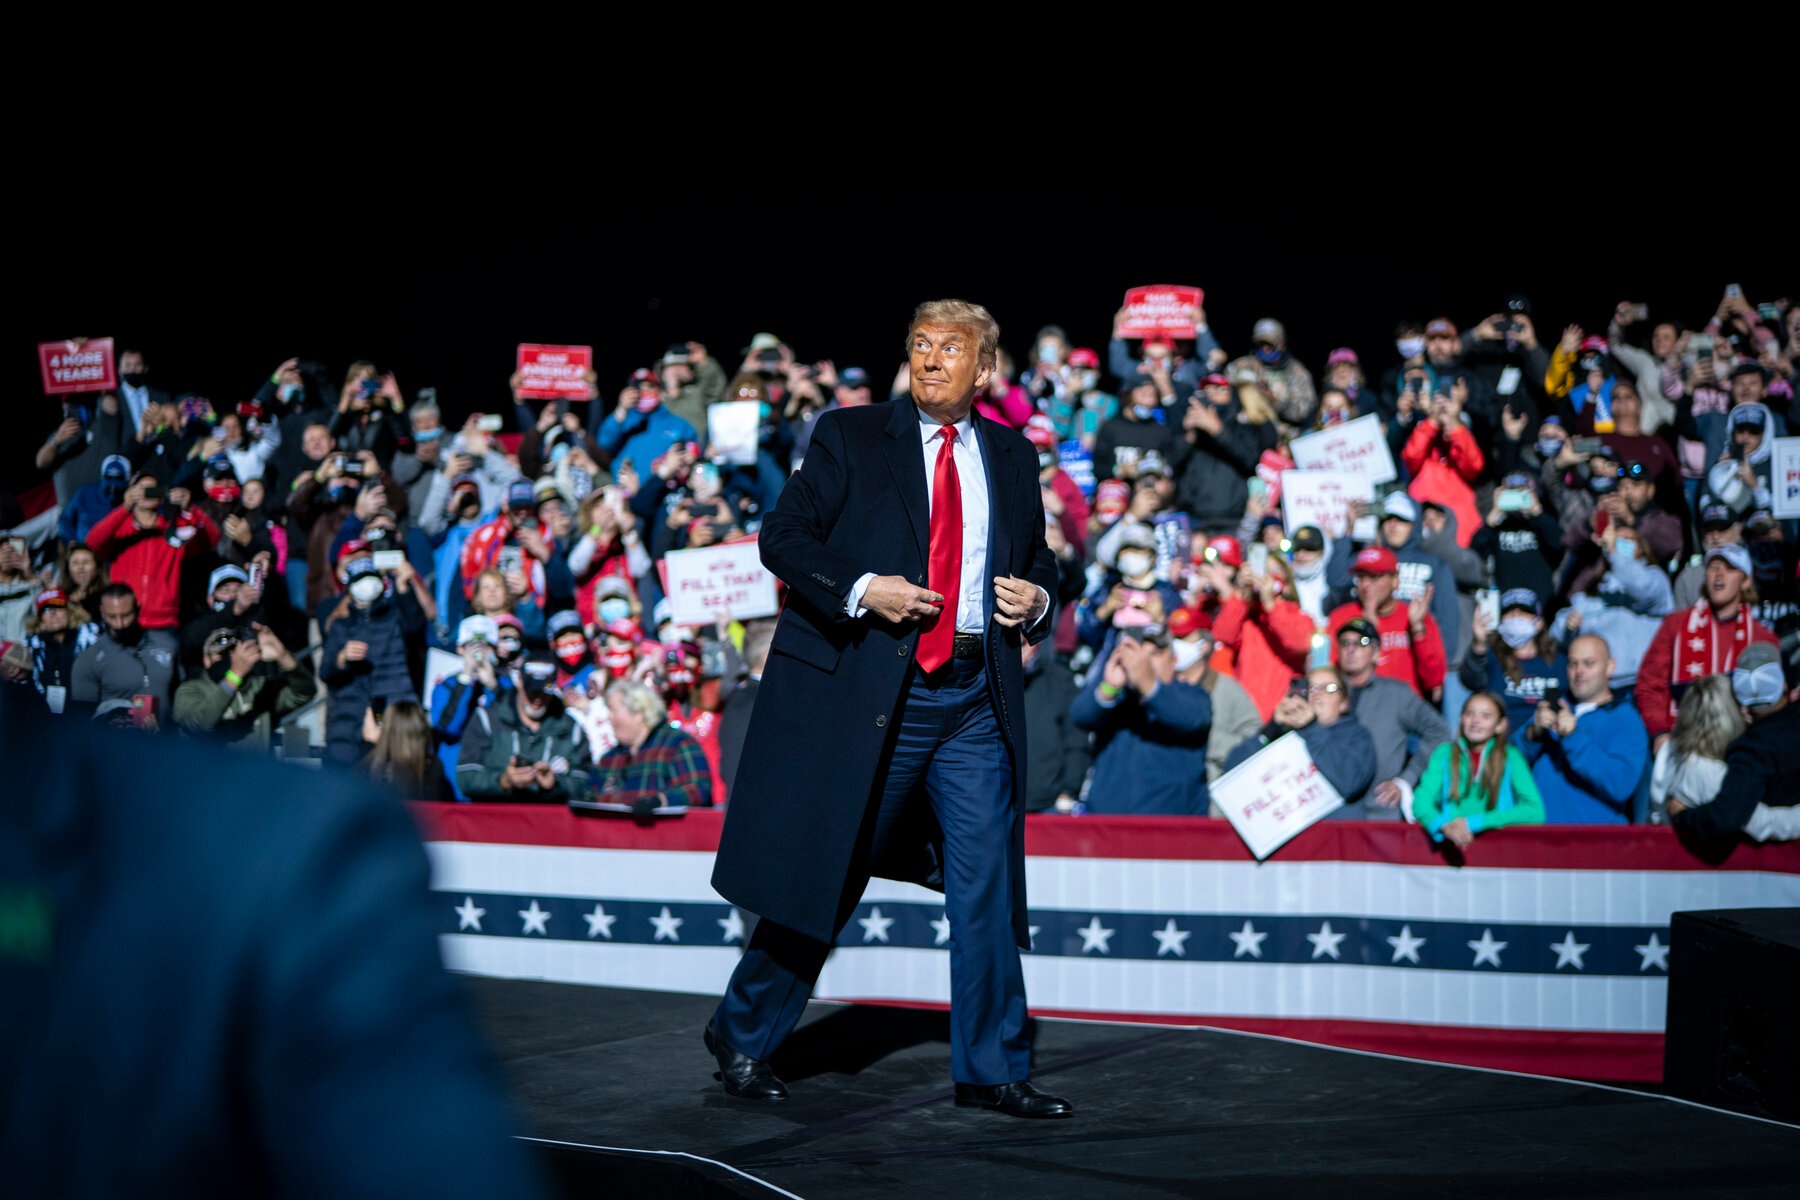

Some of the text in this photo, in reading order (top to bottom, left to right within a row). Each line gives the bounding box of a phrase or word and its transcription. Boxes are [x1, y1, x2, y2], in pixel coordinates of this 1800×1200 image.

[49, 351, 104, 368] 4 MORE
[52, 366, 105, 382] YEARS!
[681, 570, 763, 592] FILL THAT
[702, 590, 749, 607] SEAT!
